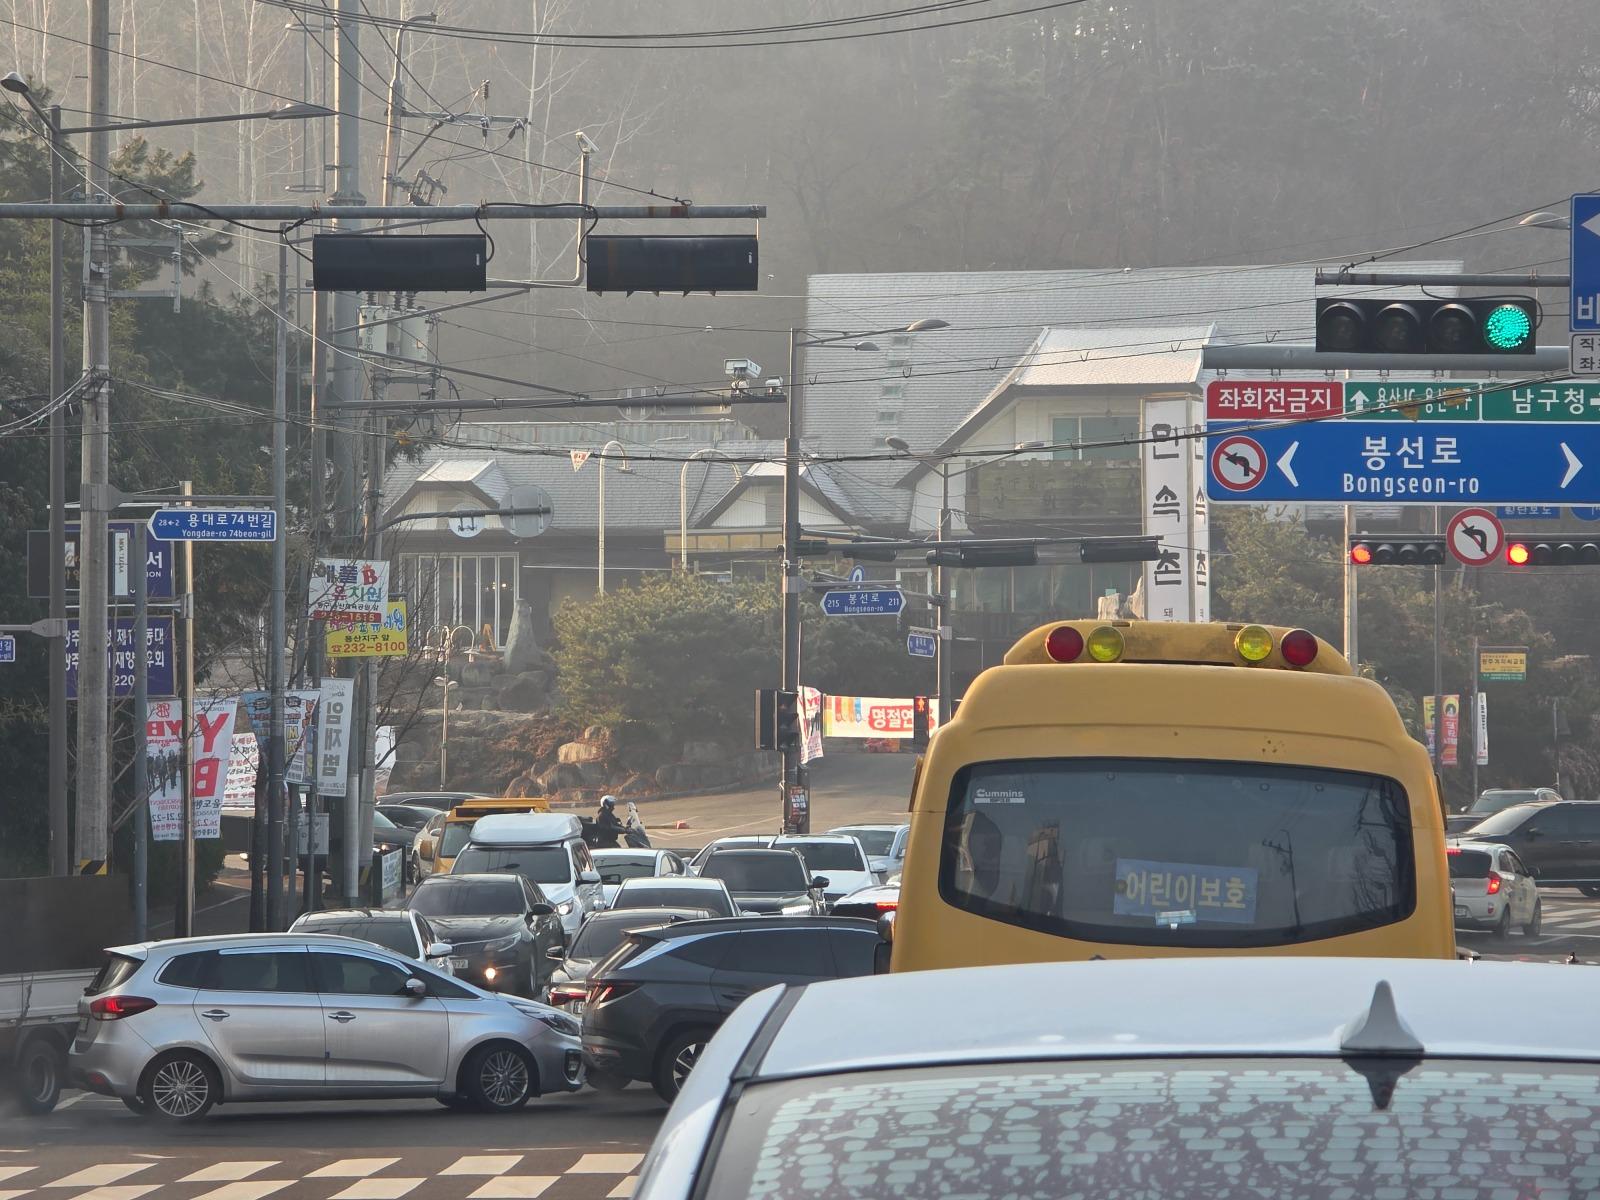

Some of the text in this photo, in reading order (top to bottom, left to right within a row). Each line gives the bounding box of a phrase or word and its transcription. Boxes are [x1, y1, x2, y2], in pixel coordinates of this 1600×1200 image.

[1218, 387, 1331, 413] 좌회전금지
[1512, 388, 1585, 415] 남구청
[1361, 436, 1462, 471] 봉선로
[1343, 473, 1480, 498] Bongseon-ro
[1151, 423, 1182, 586] 민속촌
[158, 519, 168, 527] 28
[187, 513, 272, 529] 용대로74번길
[182, 529, 272, 539] Yongdae-ro 74beon-gil
[331, 586, 382, 602] 유치원
[827, 593, 899, 608] 215 봉선로 211
[343, 641, 406, 653] 232-8100
[115, 650, 165, 670] 재향우회
[976, 788, 1024, 798] Cummins
[1126, 870, 1247, 909] 어린이보호
